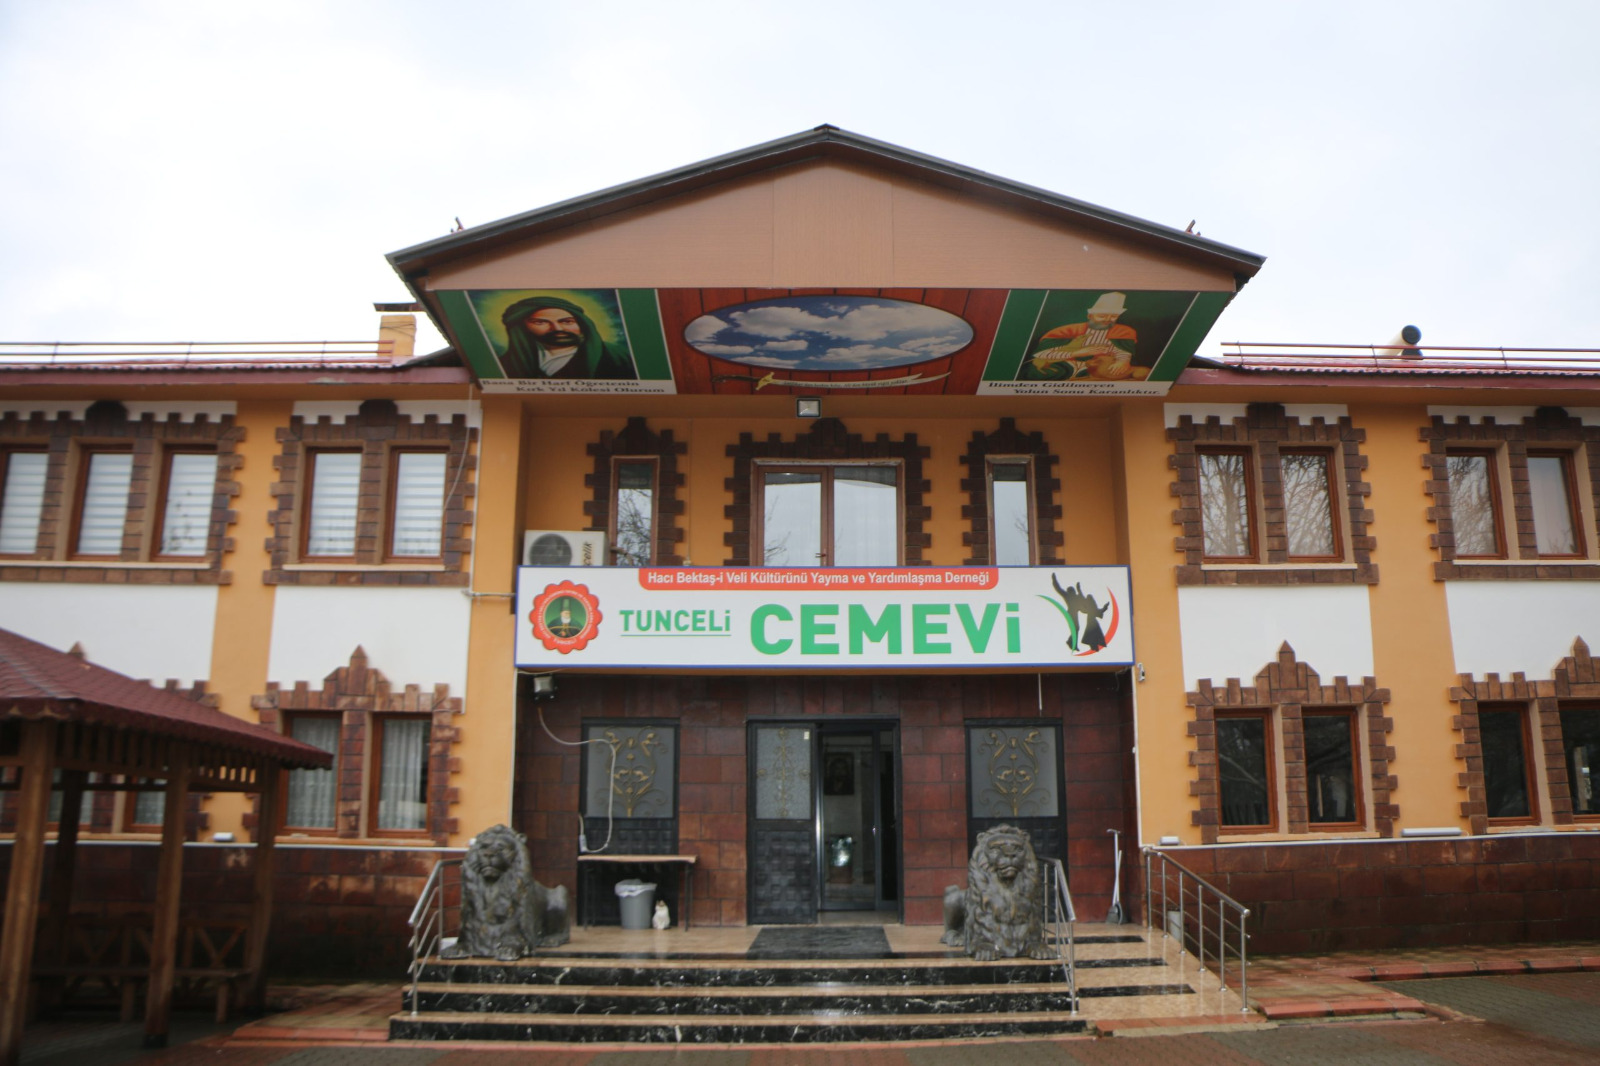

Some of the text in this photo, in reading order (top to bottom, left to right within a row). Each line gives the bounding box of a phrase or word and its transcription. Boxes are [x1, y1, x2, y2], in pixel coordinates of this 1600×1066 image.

[574, 379, 639, 387] Öğretenin
[648, 572, 990, 586] Hacı Bektaş-i Veli Kültürünü Yayma ve Yardımlaşma Derneği
